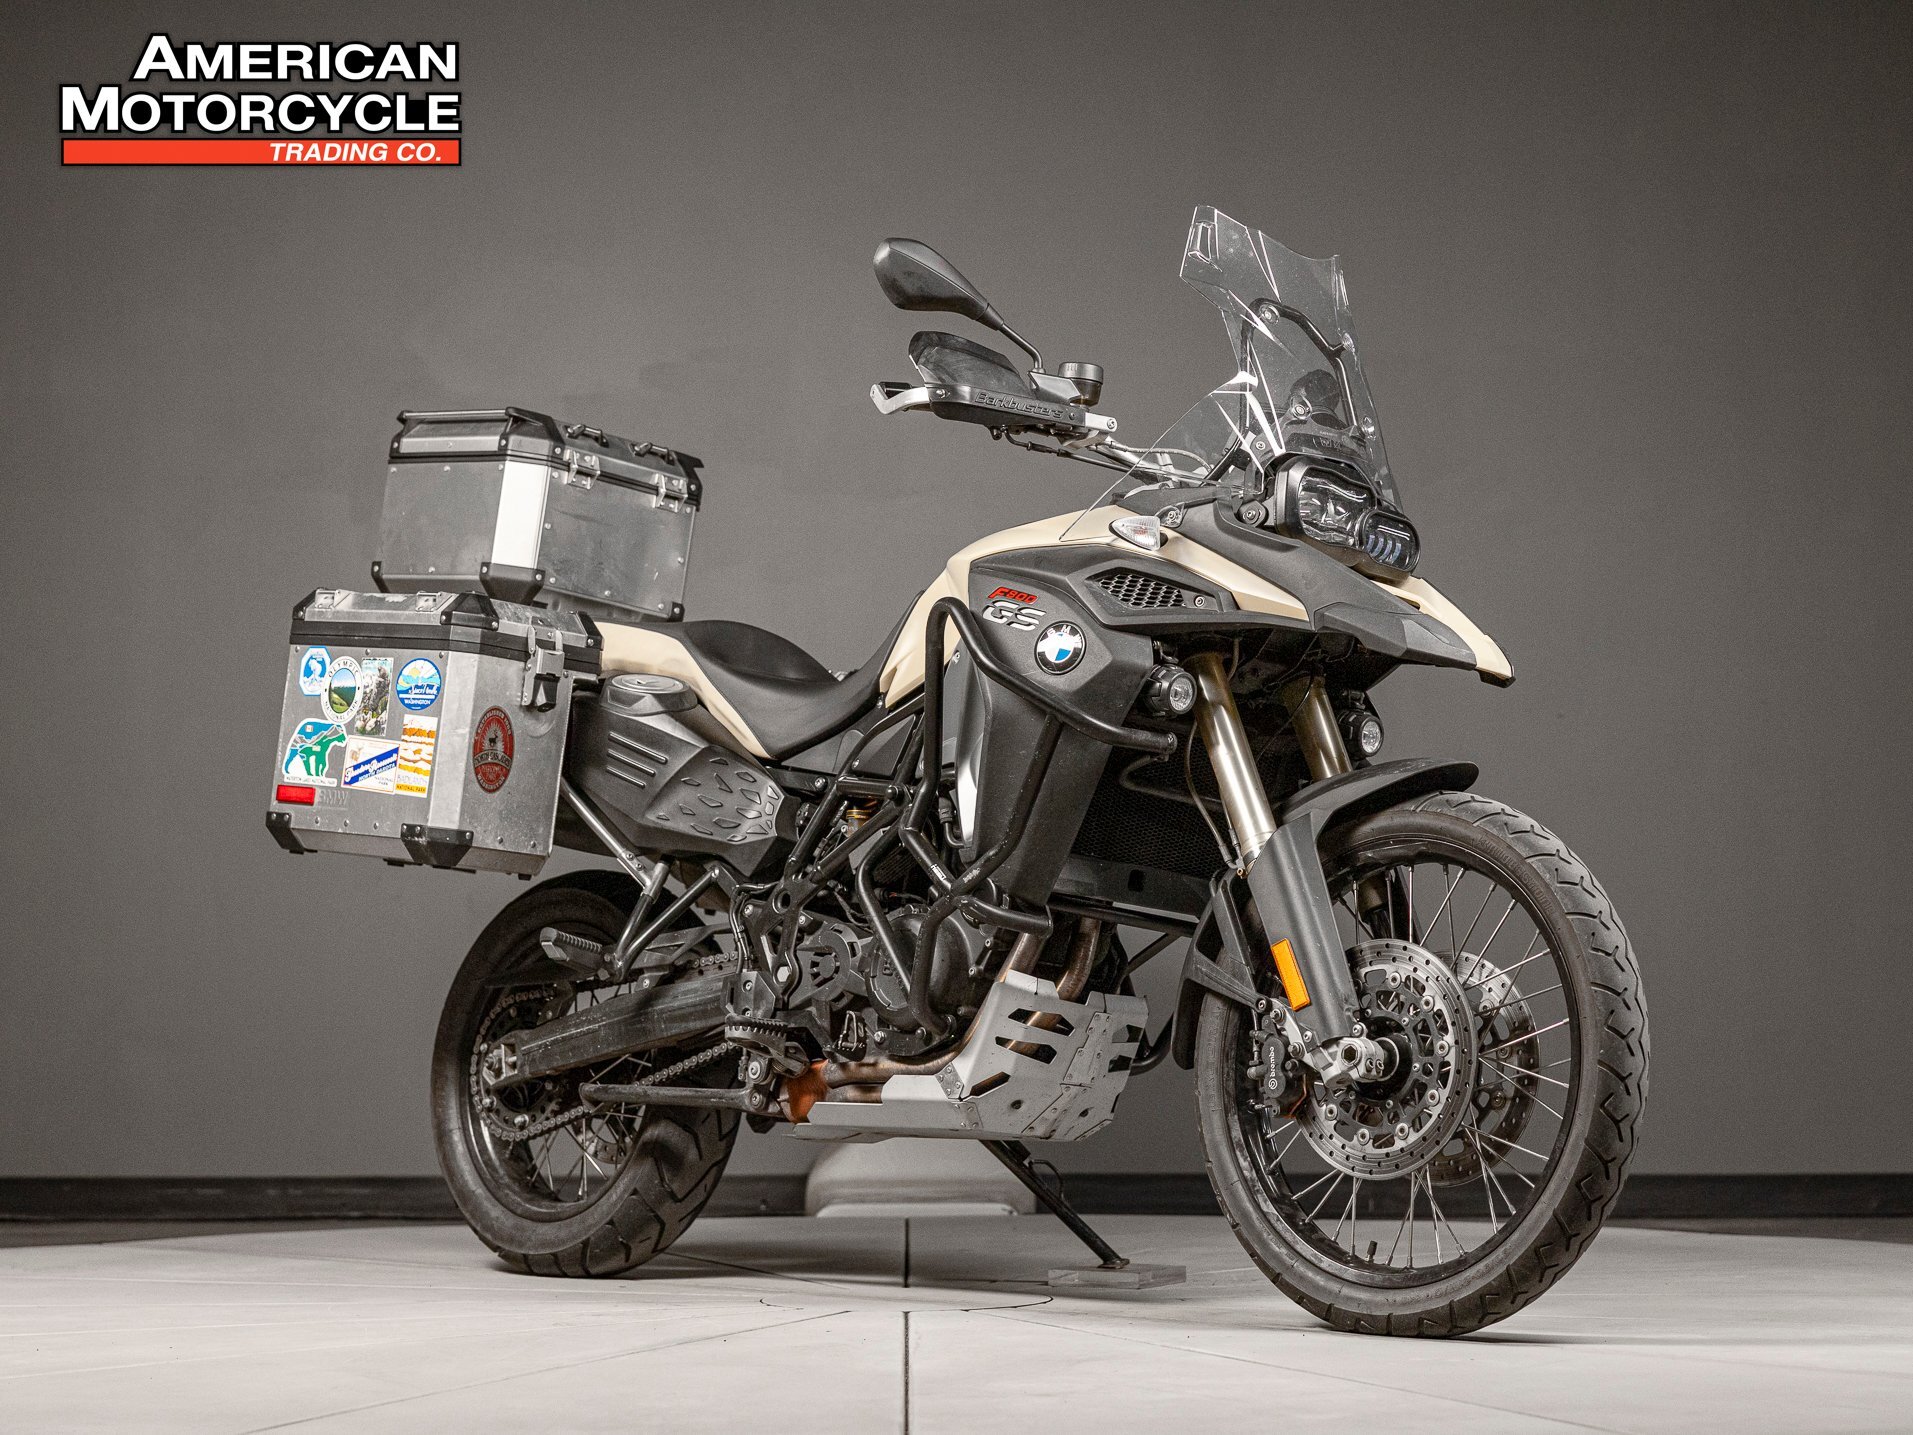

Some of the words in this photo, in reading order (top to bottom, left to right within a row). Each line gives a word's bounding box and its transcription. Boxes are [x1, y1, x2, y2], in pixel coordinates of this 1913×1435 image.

[975, 391, 1063, 419] Barkbusters
[982, 600, 1047, 631] GS
[1046, 623, 1083, 649] BMW
[328, 660, 358, 678] OLYMPIC
[1268, 1046, 1276, 1078] brembo
